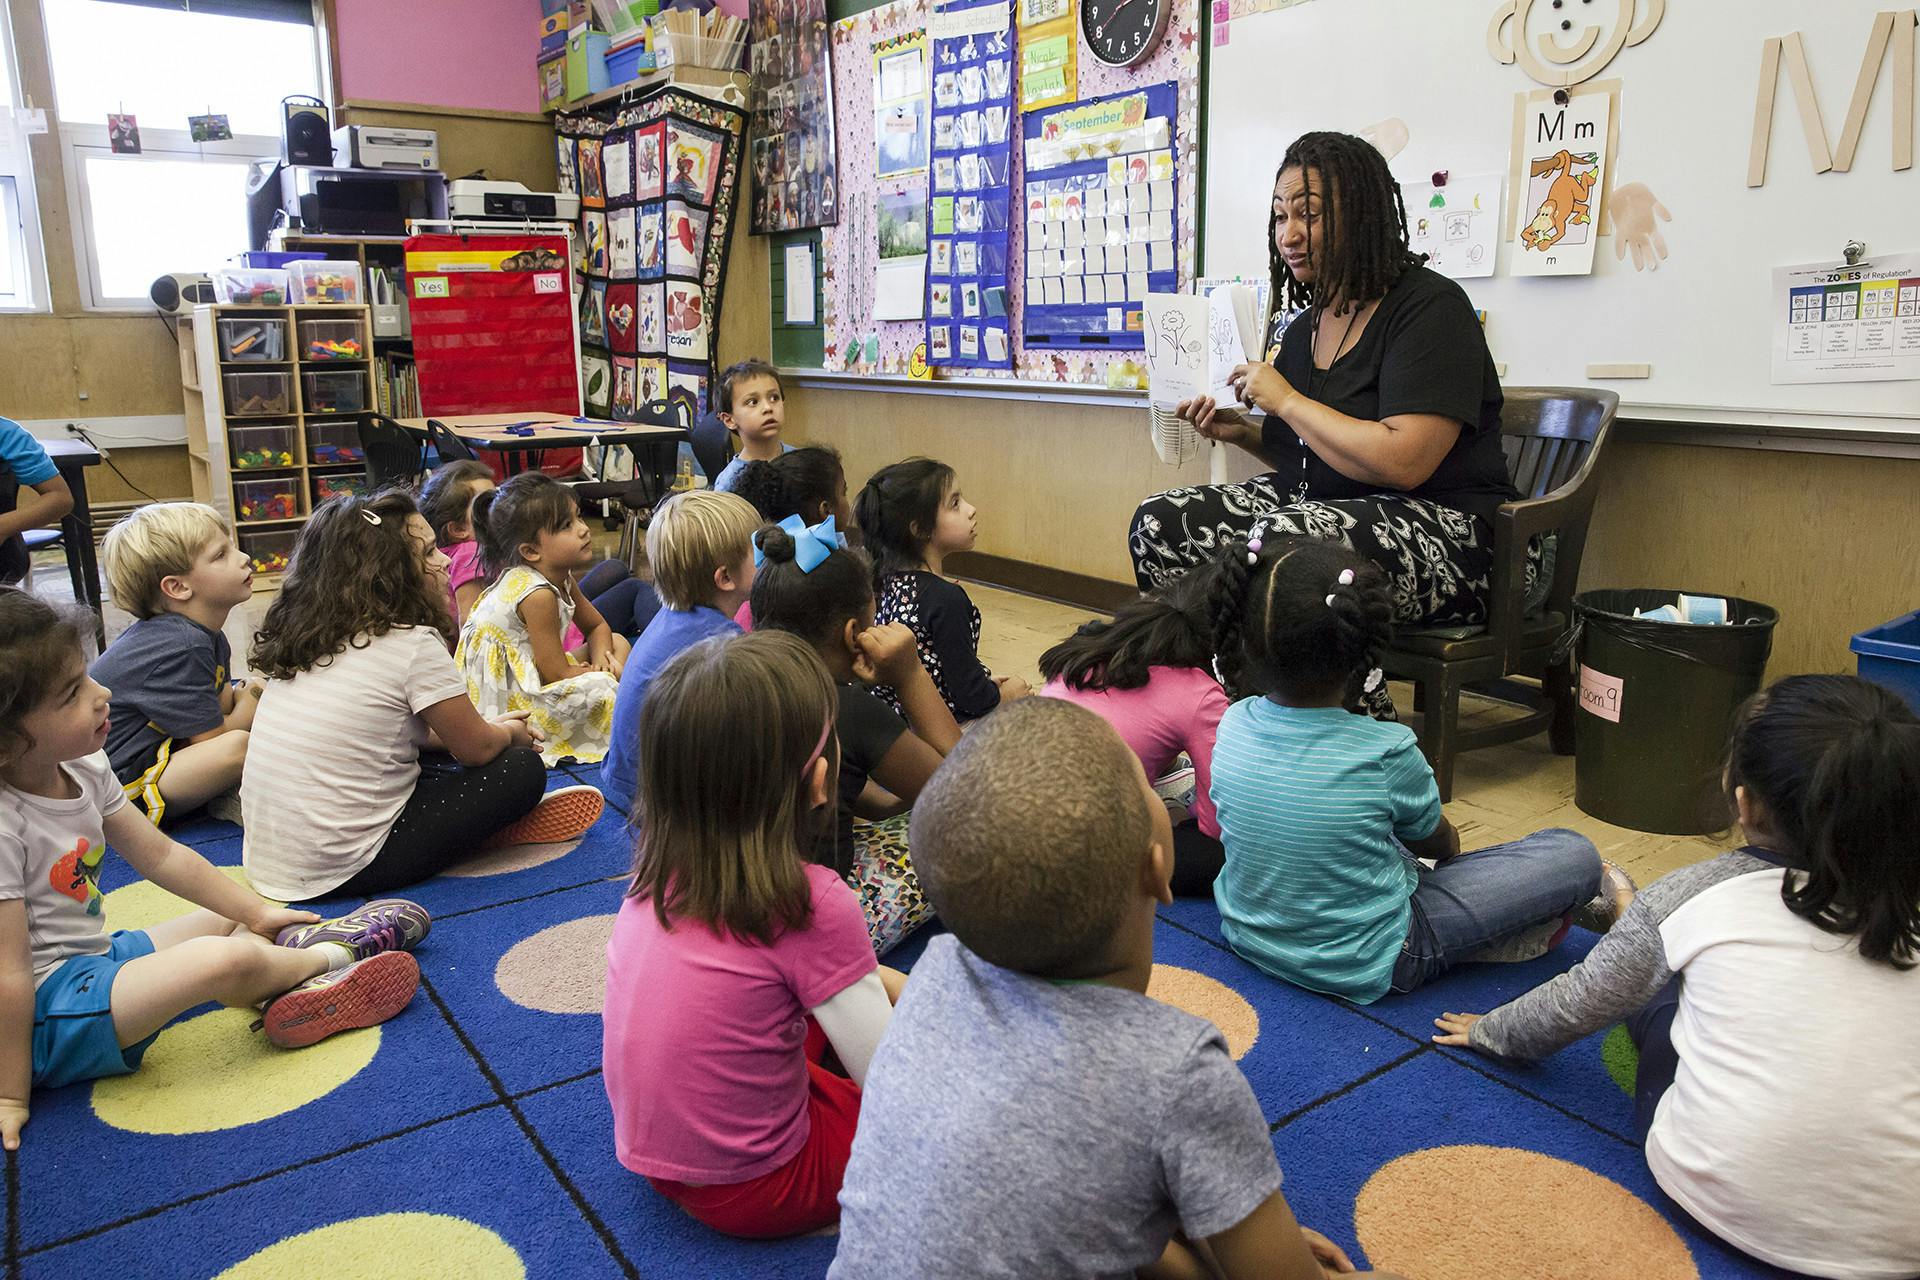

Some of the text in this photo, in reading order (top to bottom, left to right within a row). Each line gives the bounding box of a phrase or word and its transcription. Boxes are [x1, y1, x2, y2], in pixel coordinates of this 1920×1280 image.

[1092, 6, 1098, 19] 9
[1144, 14, 1150, 27] 4
[1096, 26, 1103, 39] 8
[1134, 32, 1140, 45] 5
[1106, 38, 1113, 52] 7
[1120, 41, 1126, 54] 6
[1064, 111, 1122, 131] September
[1538, 110, 1594, 143] M m
[1546, 256, 1557, 265] m
[539, 278, 557, 289] No
[1827, 271, 1862, 283] ZONES
[1862, 272, 1870, 280] of
[420, 282, 443, 293] Yes
[1606, 687, 1617, 712] 9
